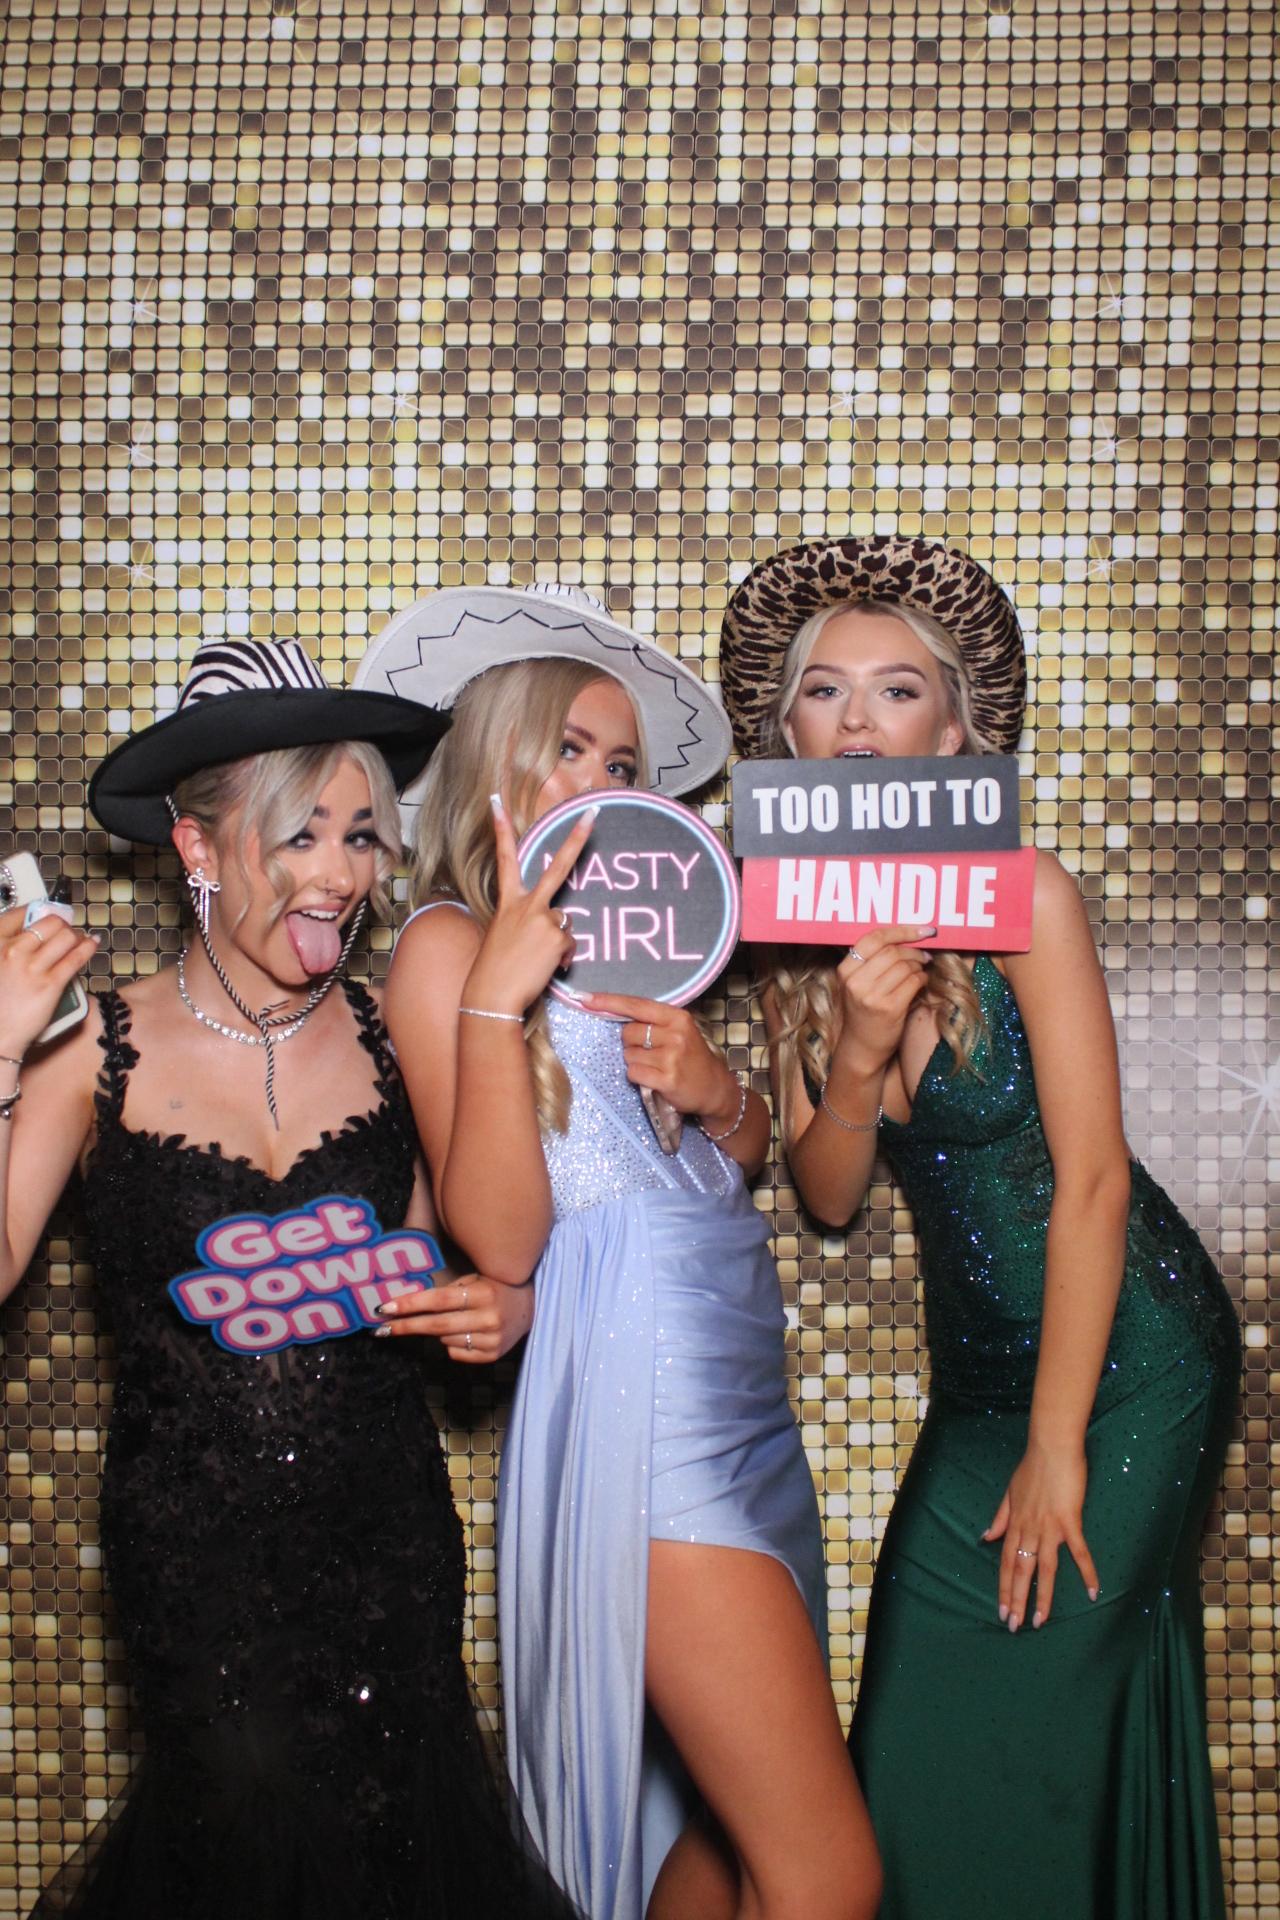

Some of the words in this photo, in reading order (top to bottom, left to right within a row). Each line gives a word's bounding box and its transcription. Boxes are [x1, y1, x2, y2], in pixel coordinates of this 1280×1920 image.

[752, 785, 840, 835] TOO
[851, 778, 937, 832] HOT
[945, 777, 1001, 825] TO
[776, 858, 998, 928] HANDLE
[562, 906, 704, 962] GIRL
[211, 1205, 368, 1266] Get
[184, 1240, 429, 1317] Down
[225, 1302, 345, 1347] On
